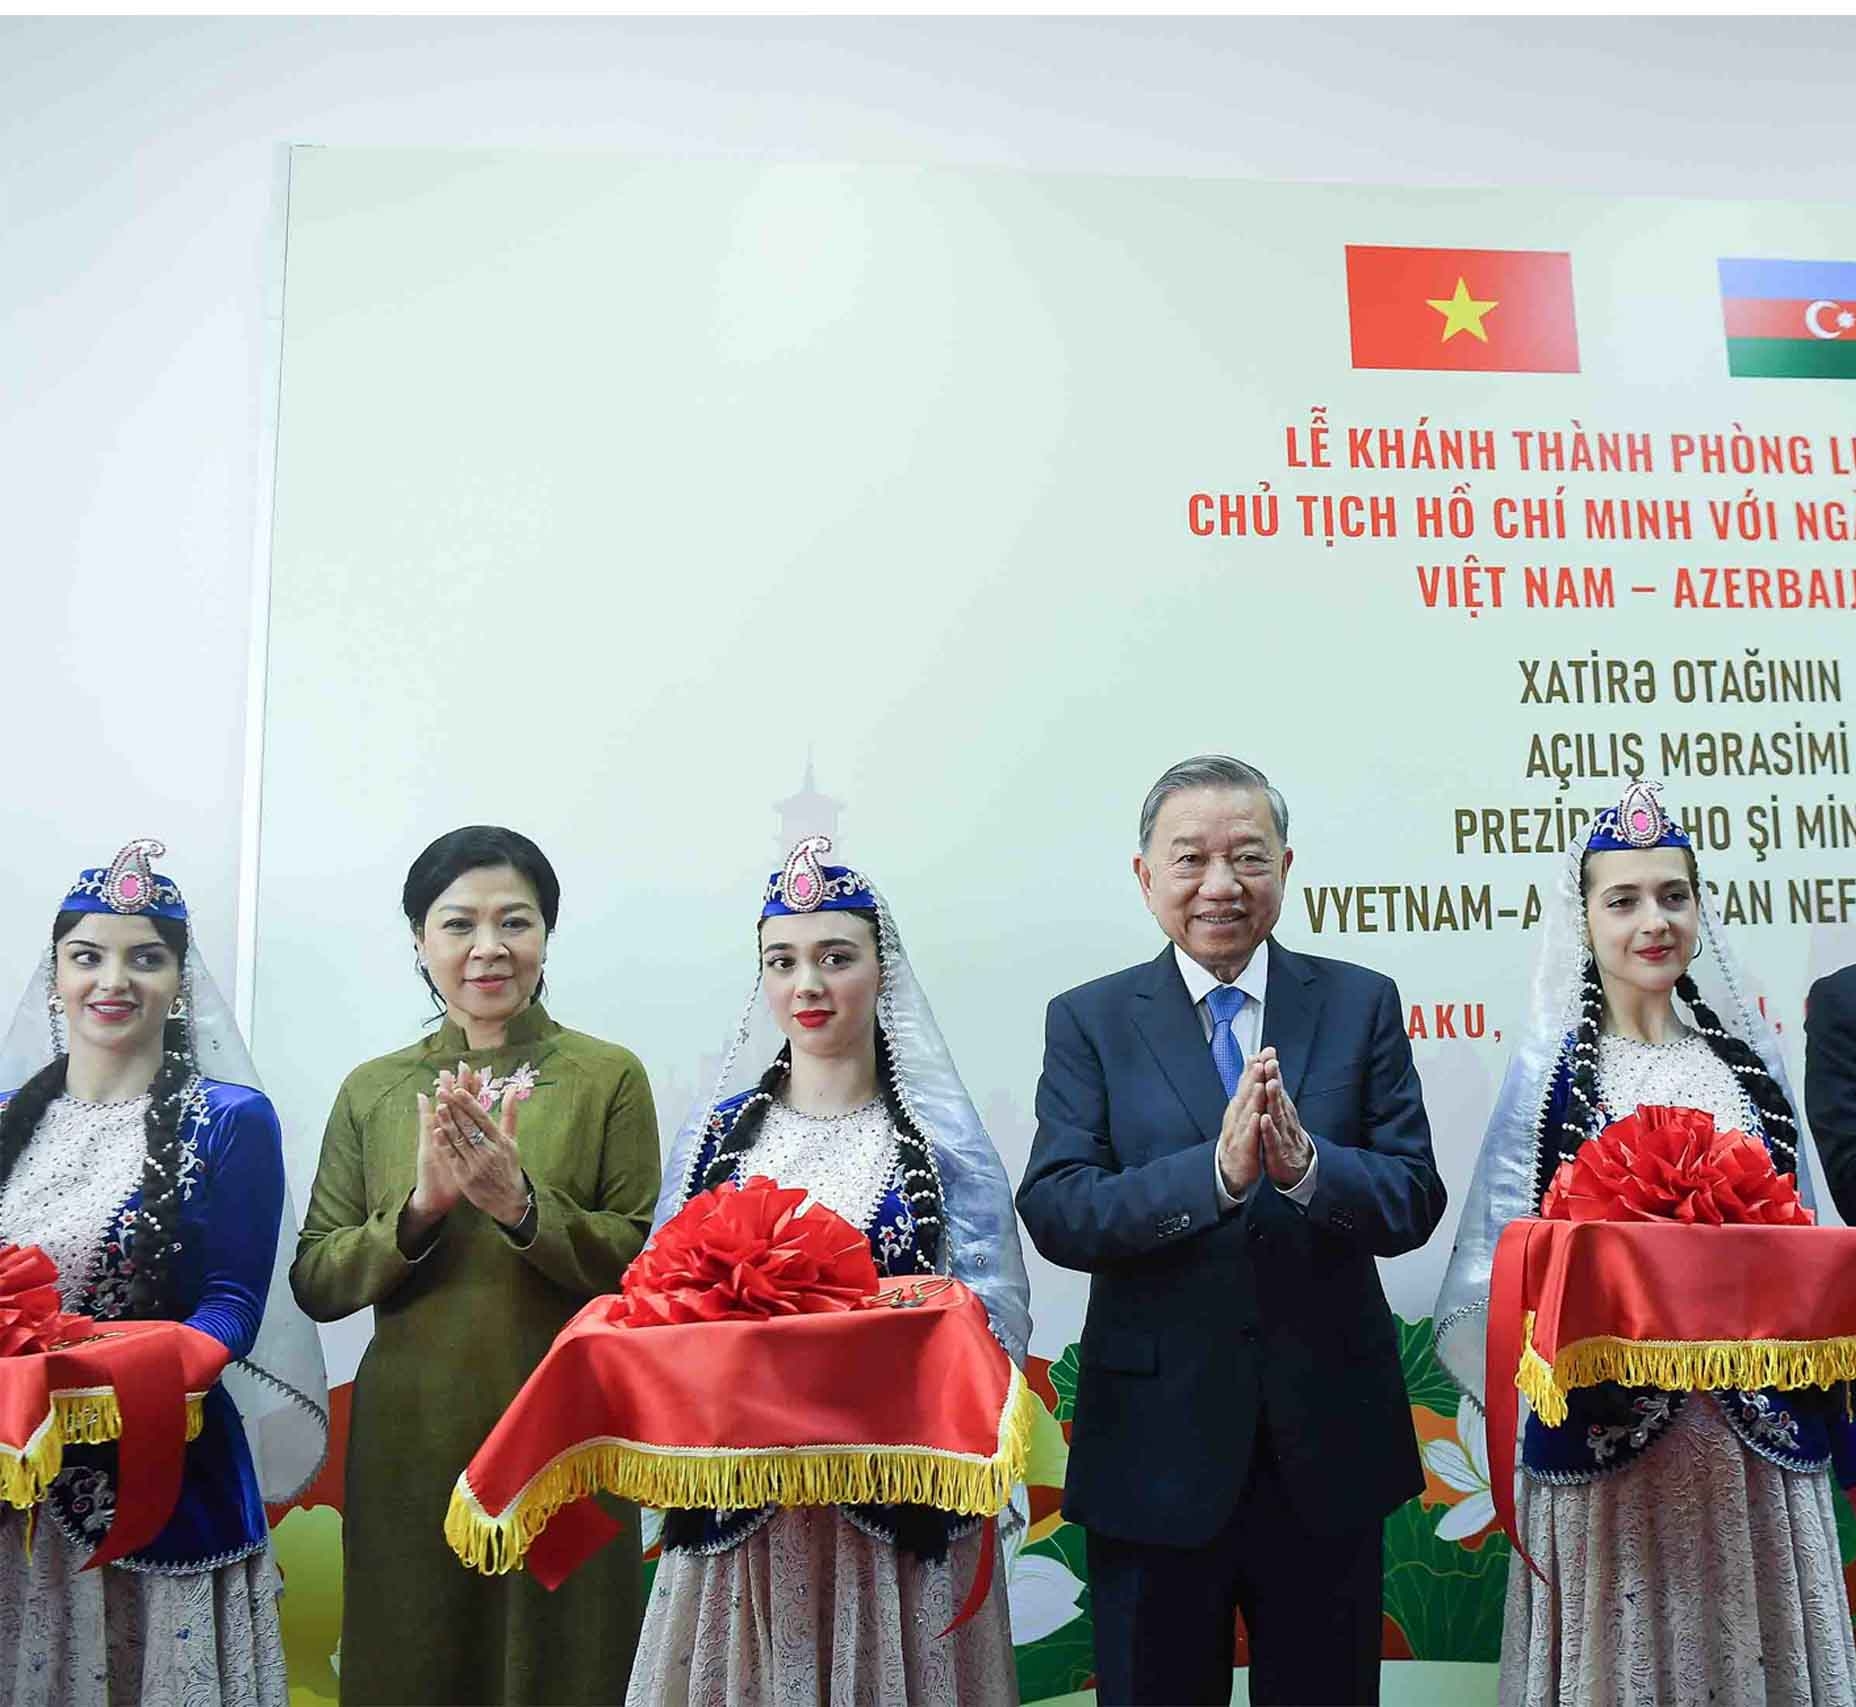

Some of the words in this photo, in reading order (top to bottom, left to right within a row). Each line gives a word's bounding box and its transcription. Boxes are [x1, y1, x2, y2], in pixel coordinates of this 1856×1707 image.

[1286, 405, 1332, 468] LỄ
[1348, 415, 1496, 470] KHÁNH
[1512, 418, 1654, 473] THÀNH
[1670, 420, 1814, 475] PHÒNG
[1188, 480, 1280, 538] CHỦ
[1296, 494, 1398, 548] TỊCH
[1416, 481, 1475, 539] HỒ
[1493, 485, 1567, 541] CHÍ
[1584, 498, 1693, 541] MINH
[1708, 487, 1779, 542] VỚI
[1416, 554, 1506, 619] VIỆT
[1523, 566, 1616, 609] NAM
[1517, 648, 1657, 704] XATİRƏ
[1672, 647, 1842, 704] OTAĞININ
[1525, 732, 1646, 790] AÇILIŞ
[1660, 720, 1851, 778] MƏRASİMİ
[1681, 804, 1731, 851] HO
[1746, 794, 1782, 862] Şİ
[1407, 1003, 1502, 1043] AKU,
